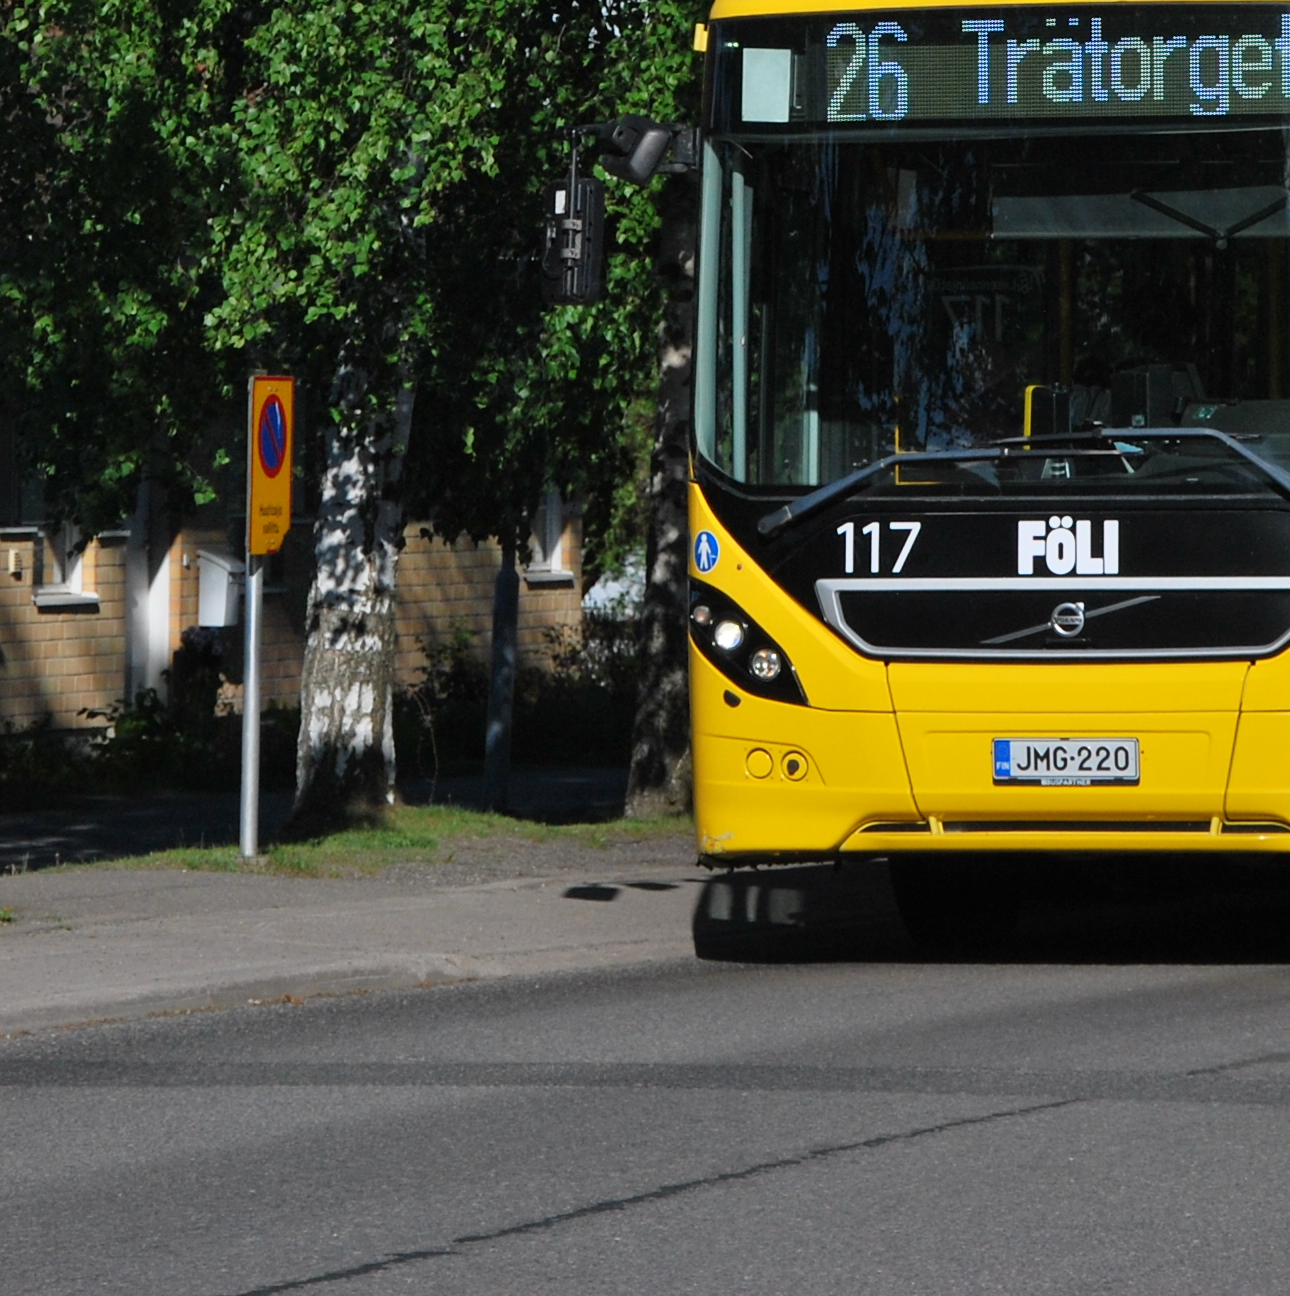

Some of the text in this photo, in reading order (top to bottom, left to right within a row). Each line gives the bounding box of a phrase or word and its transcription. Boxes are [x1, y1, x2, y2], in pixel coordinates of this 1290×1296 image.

[826, 21, 909, 122] 26
[836, 521, 921, 575] 117
[1017, 515, 1120, 576] FÖLI
[996, 761, 1010, 770] FIN
[1016, 745, 1130, 772] JMG-220
